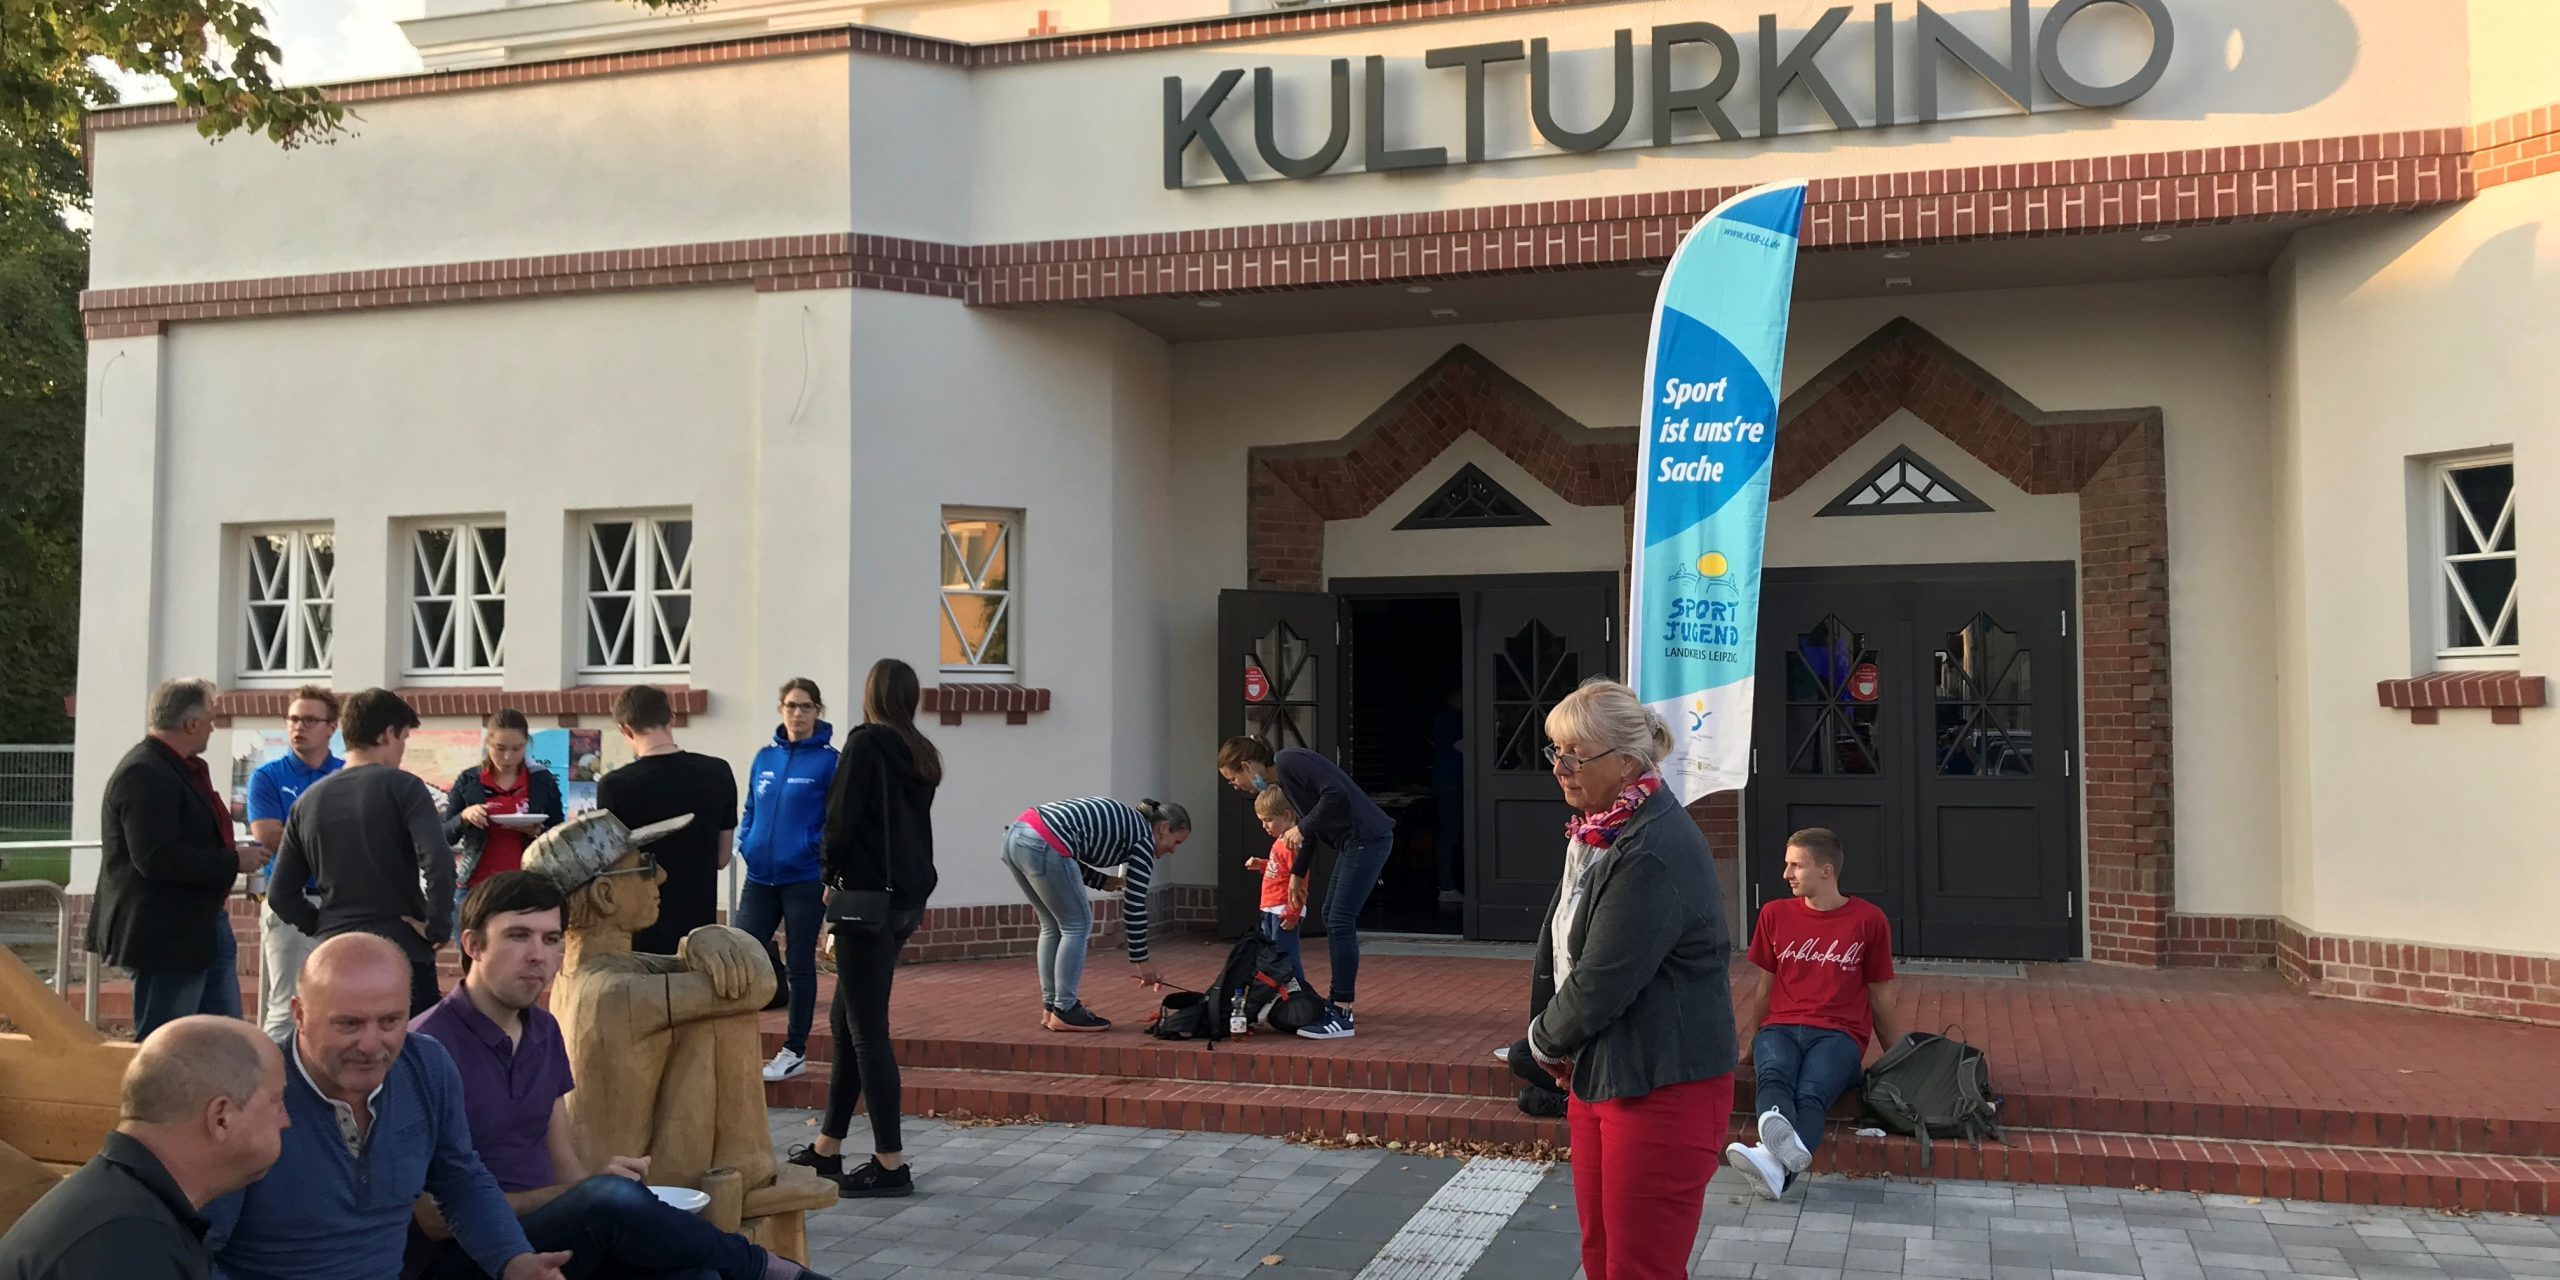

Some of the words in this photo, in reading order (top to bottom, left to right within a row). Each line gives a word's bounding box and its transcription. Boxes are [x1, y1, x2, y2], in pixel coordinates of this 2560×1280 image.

[1163, 0, 2175, 190] KULTURKINO
[1662, 376, 1727, 409] Sport
[1659, 416, 1689, 443] ist
[1657, 455, 1724, 482] Sache
[1668, 597, 1739, 622] SPORT
[1663, 620, 1739, 646] JUGEND
[1664, 647, 1706, 660] LANDKREIS
[1708, 650, 1737, 663] LEIPZIG
